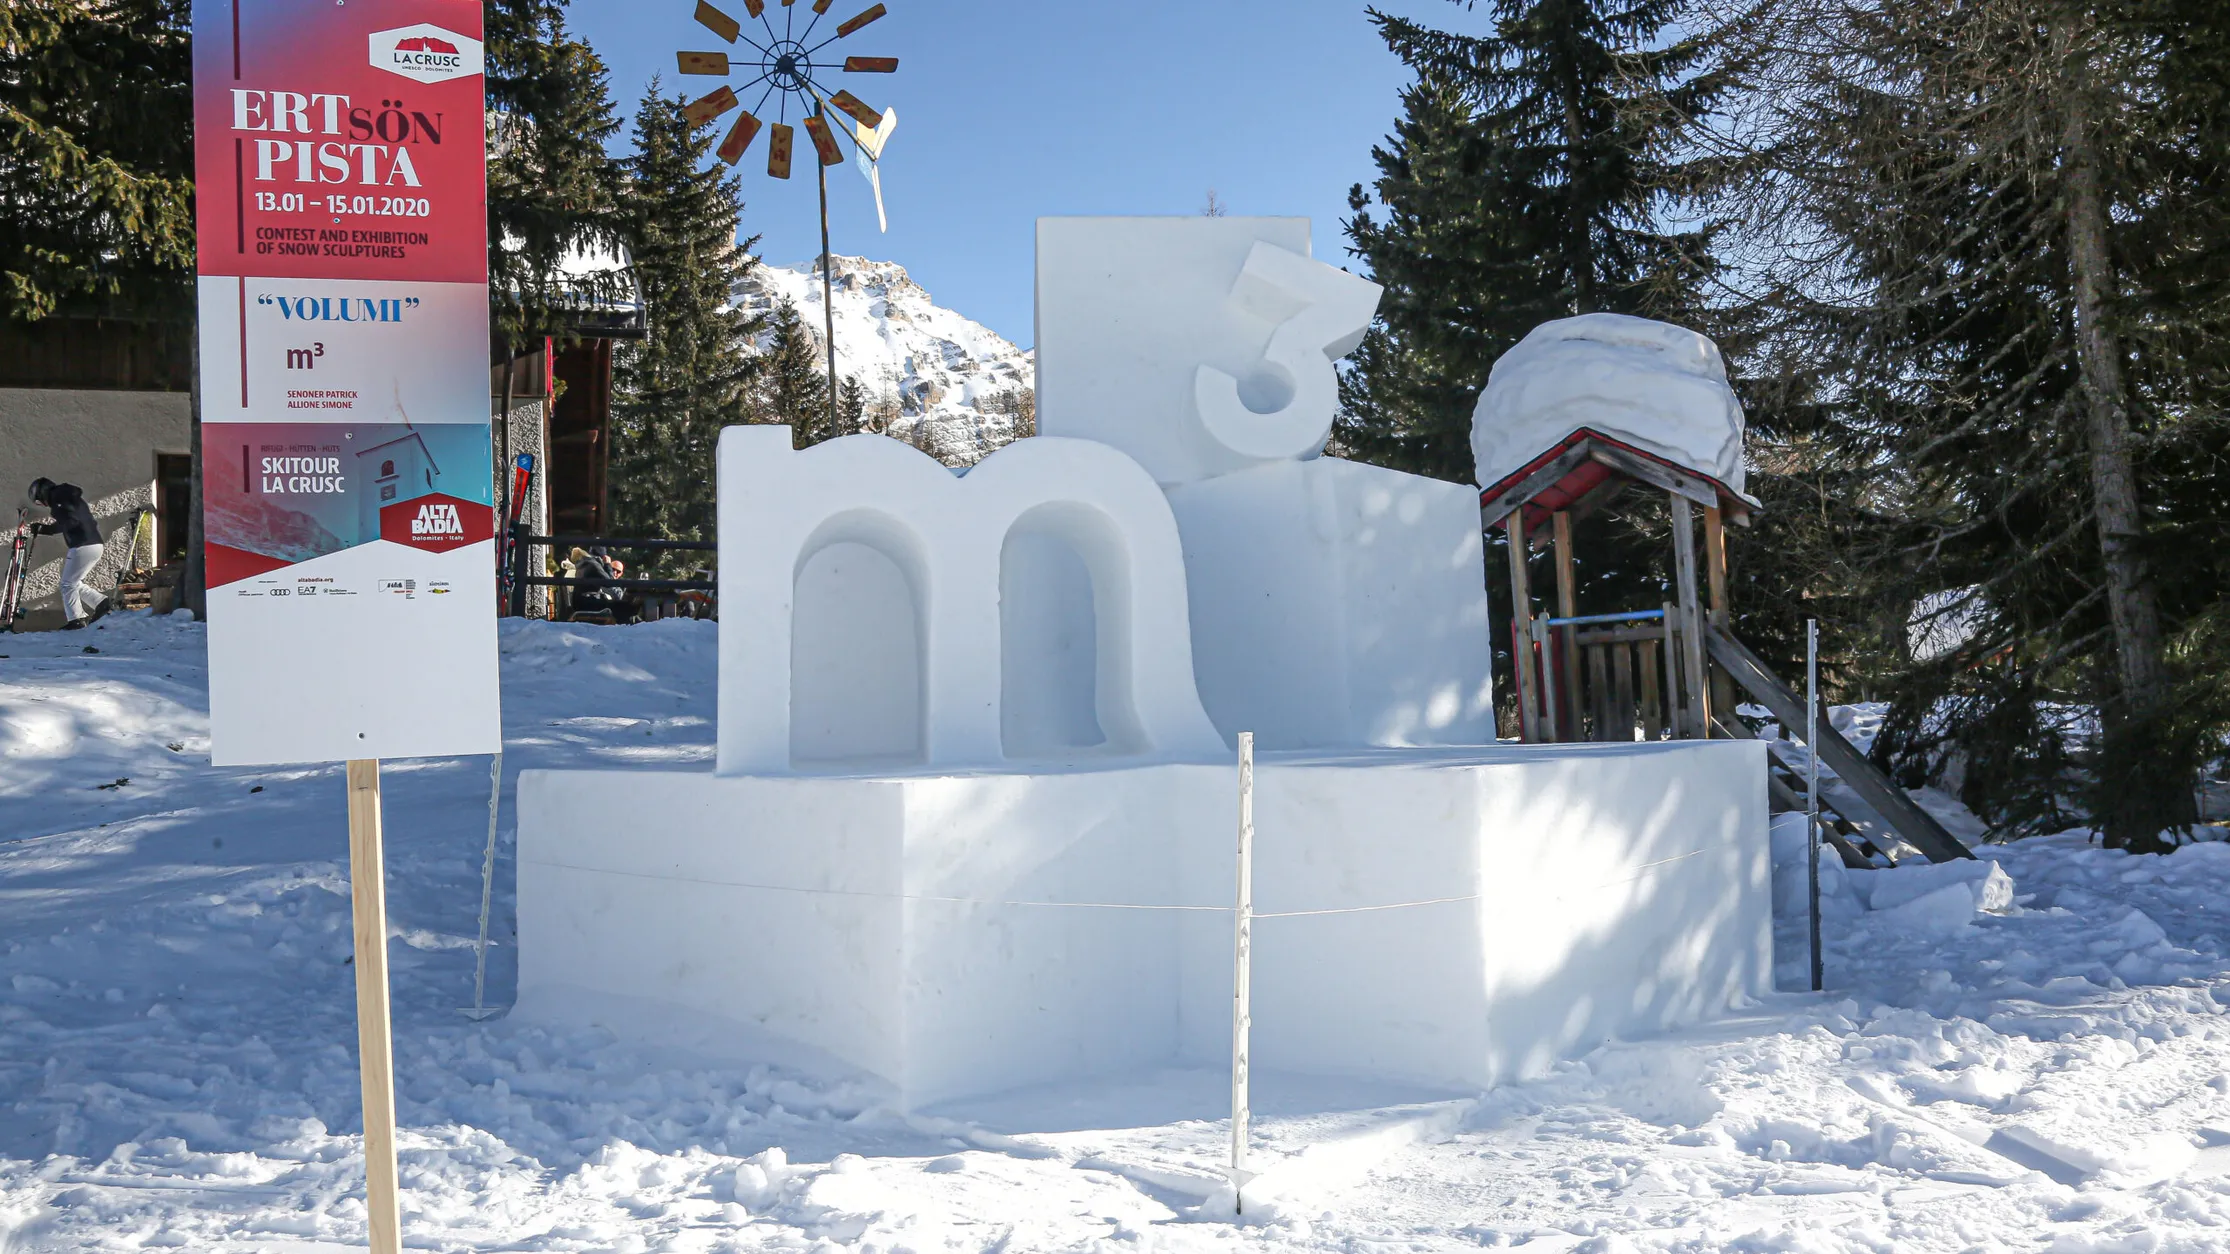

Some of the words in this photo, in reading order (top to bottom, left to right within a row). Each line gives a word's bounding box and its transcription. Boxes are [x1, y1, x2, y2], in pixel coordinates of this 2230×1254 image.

[394, 53, 412, 64] LA
[414, 54, 460, 67] CRUSC
[230, 88, 350, 135] ERT
[254, 139, 422, 187] PISTA
[255, 192, 304, 212] 13.01
[326, 195, 430, 217] 15.01.2020
[256, 227, 316, 241] CONTEST
[319, 230, 348, 242] AND
[352, 231, 428, 245] EXHIBITION
[256, 242, 274, 254] OF
[278, 243, 320, 256] SNOW
[323, 245, 405, 259] SCULPTURES
[287, 390, 324, 398] SENONER
[262, 457, 340, 474] SKITOUR
[262, 476, 285, 493] LA
[289, 476, 345, 493] CRUSC
[417, 504, 457, 519] ALTA
[411, 519, 464, 534] BADIA
